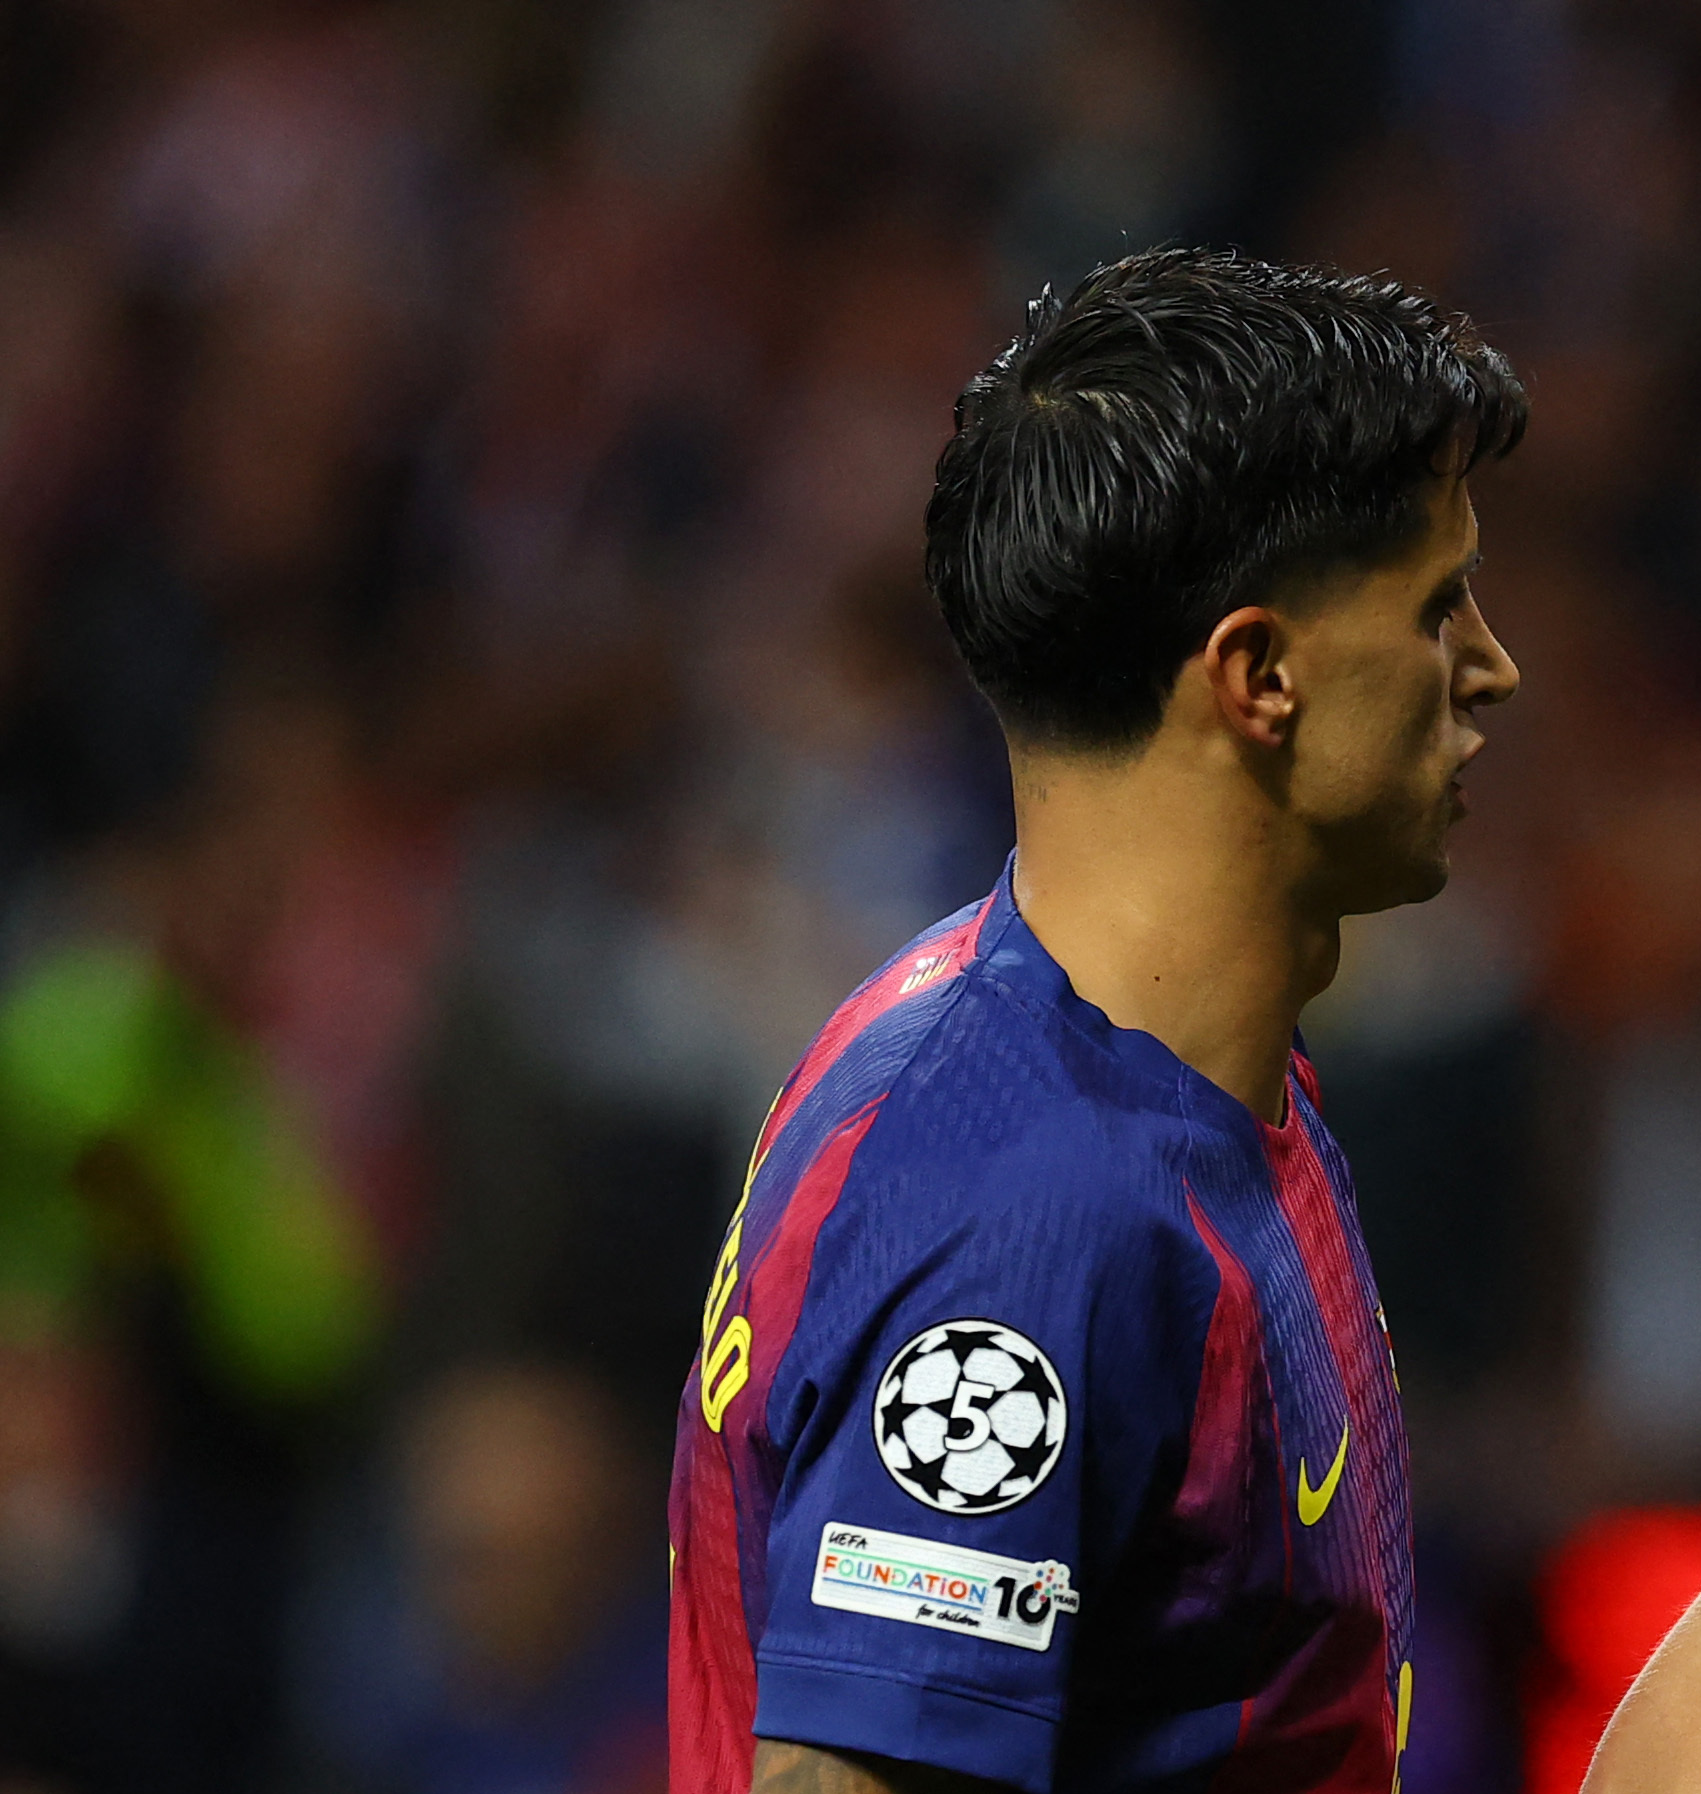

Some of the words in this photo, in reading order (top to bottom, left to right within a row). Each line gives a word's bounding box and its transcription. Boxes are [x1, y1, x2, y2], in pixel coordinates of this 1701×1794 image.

[943, 1380, 996, 1452] 5
[828, 1531, 868, 1550] UEFA
[823, 1555, 988, 1604] FOUNDATION
[995, 1576, 1051, 1624] 10
[915, 1603, 935, 1619] for
[937, 1610, 981, 1627] children
